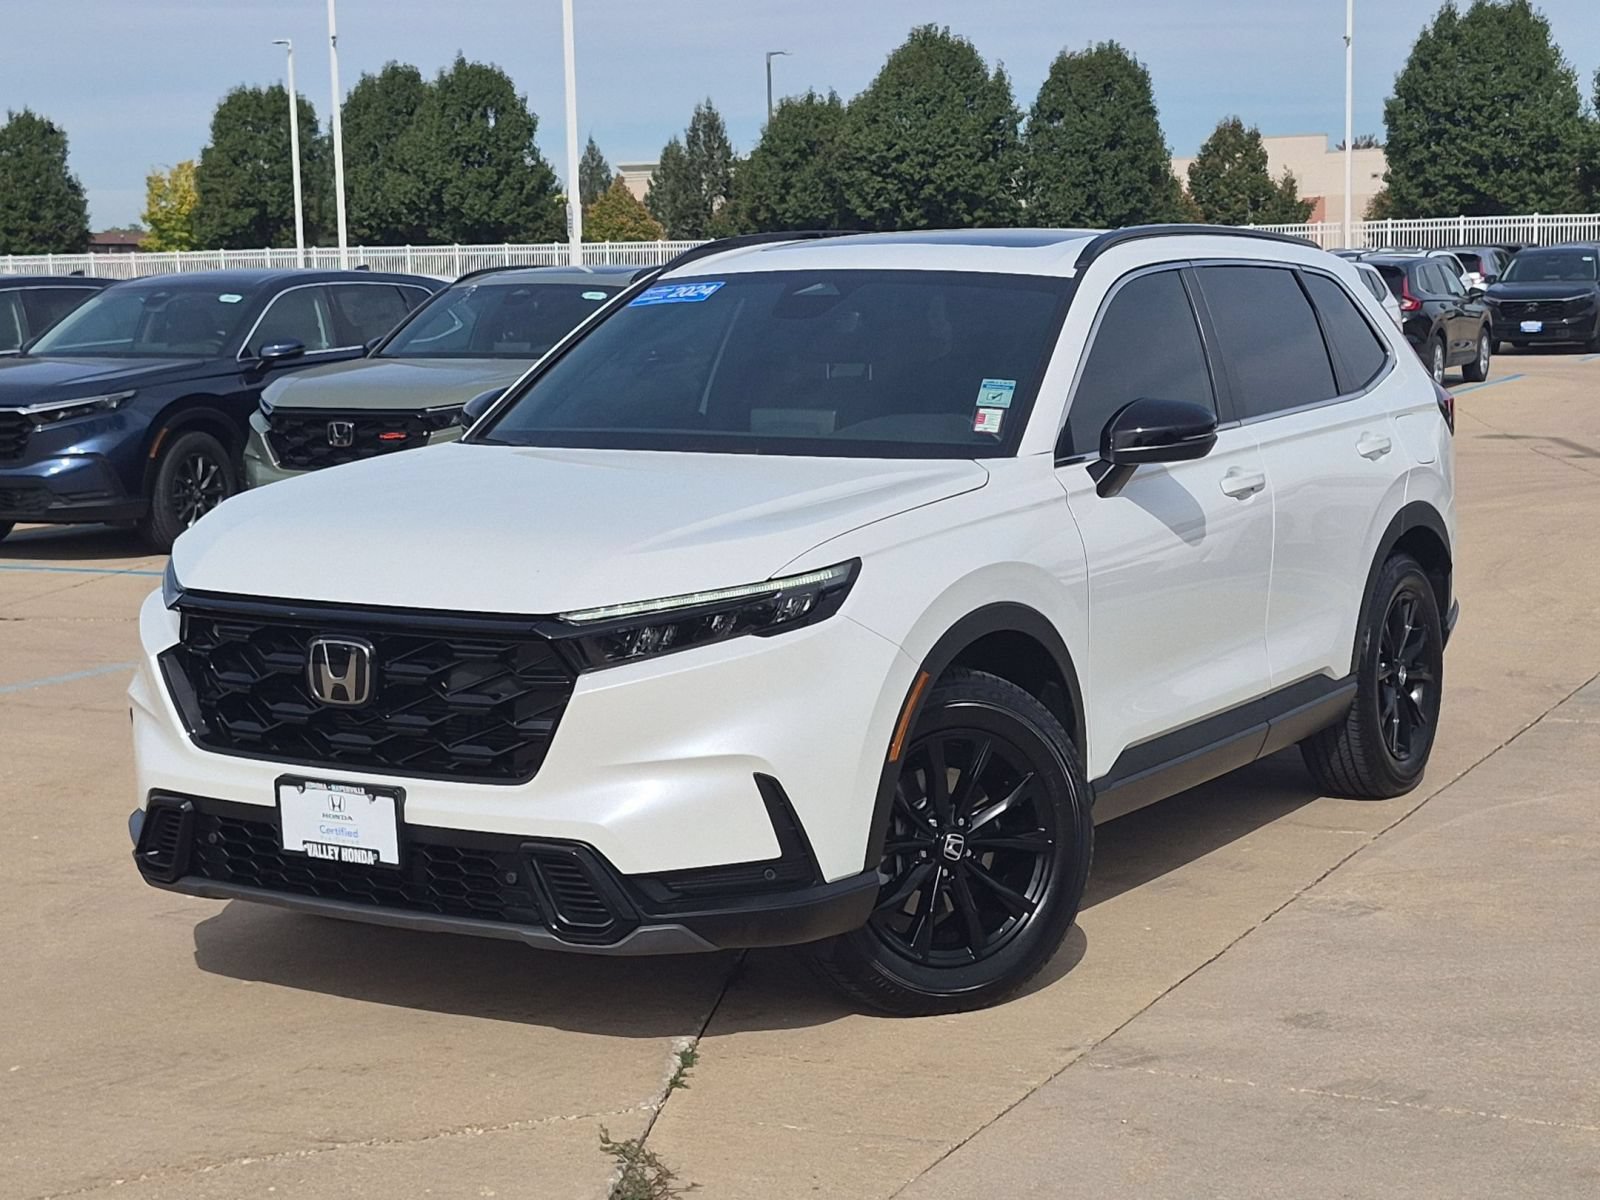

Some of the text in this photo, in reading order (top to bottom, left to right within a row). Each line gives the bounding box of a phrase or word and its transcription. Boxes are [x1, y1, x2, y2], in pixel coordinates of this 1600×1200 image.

[667, 284, 717, 298] 2024
[322, 812, 354, 821] HONDA
[319, 824, 359, 839] Certified
[307, 843, 375, 865] VALLEY HONDA
